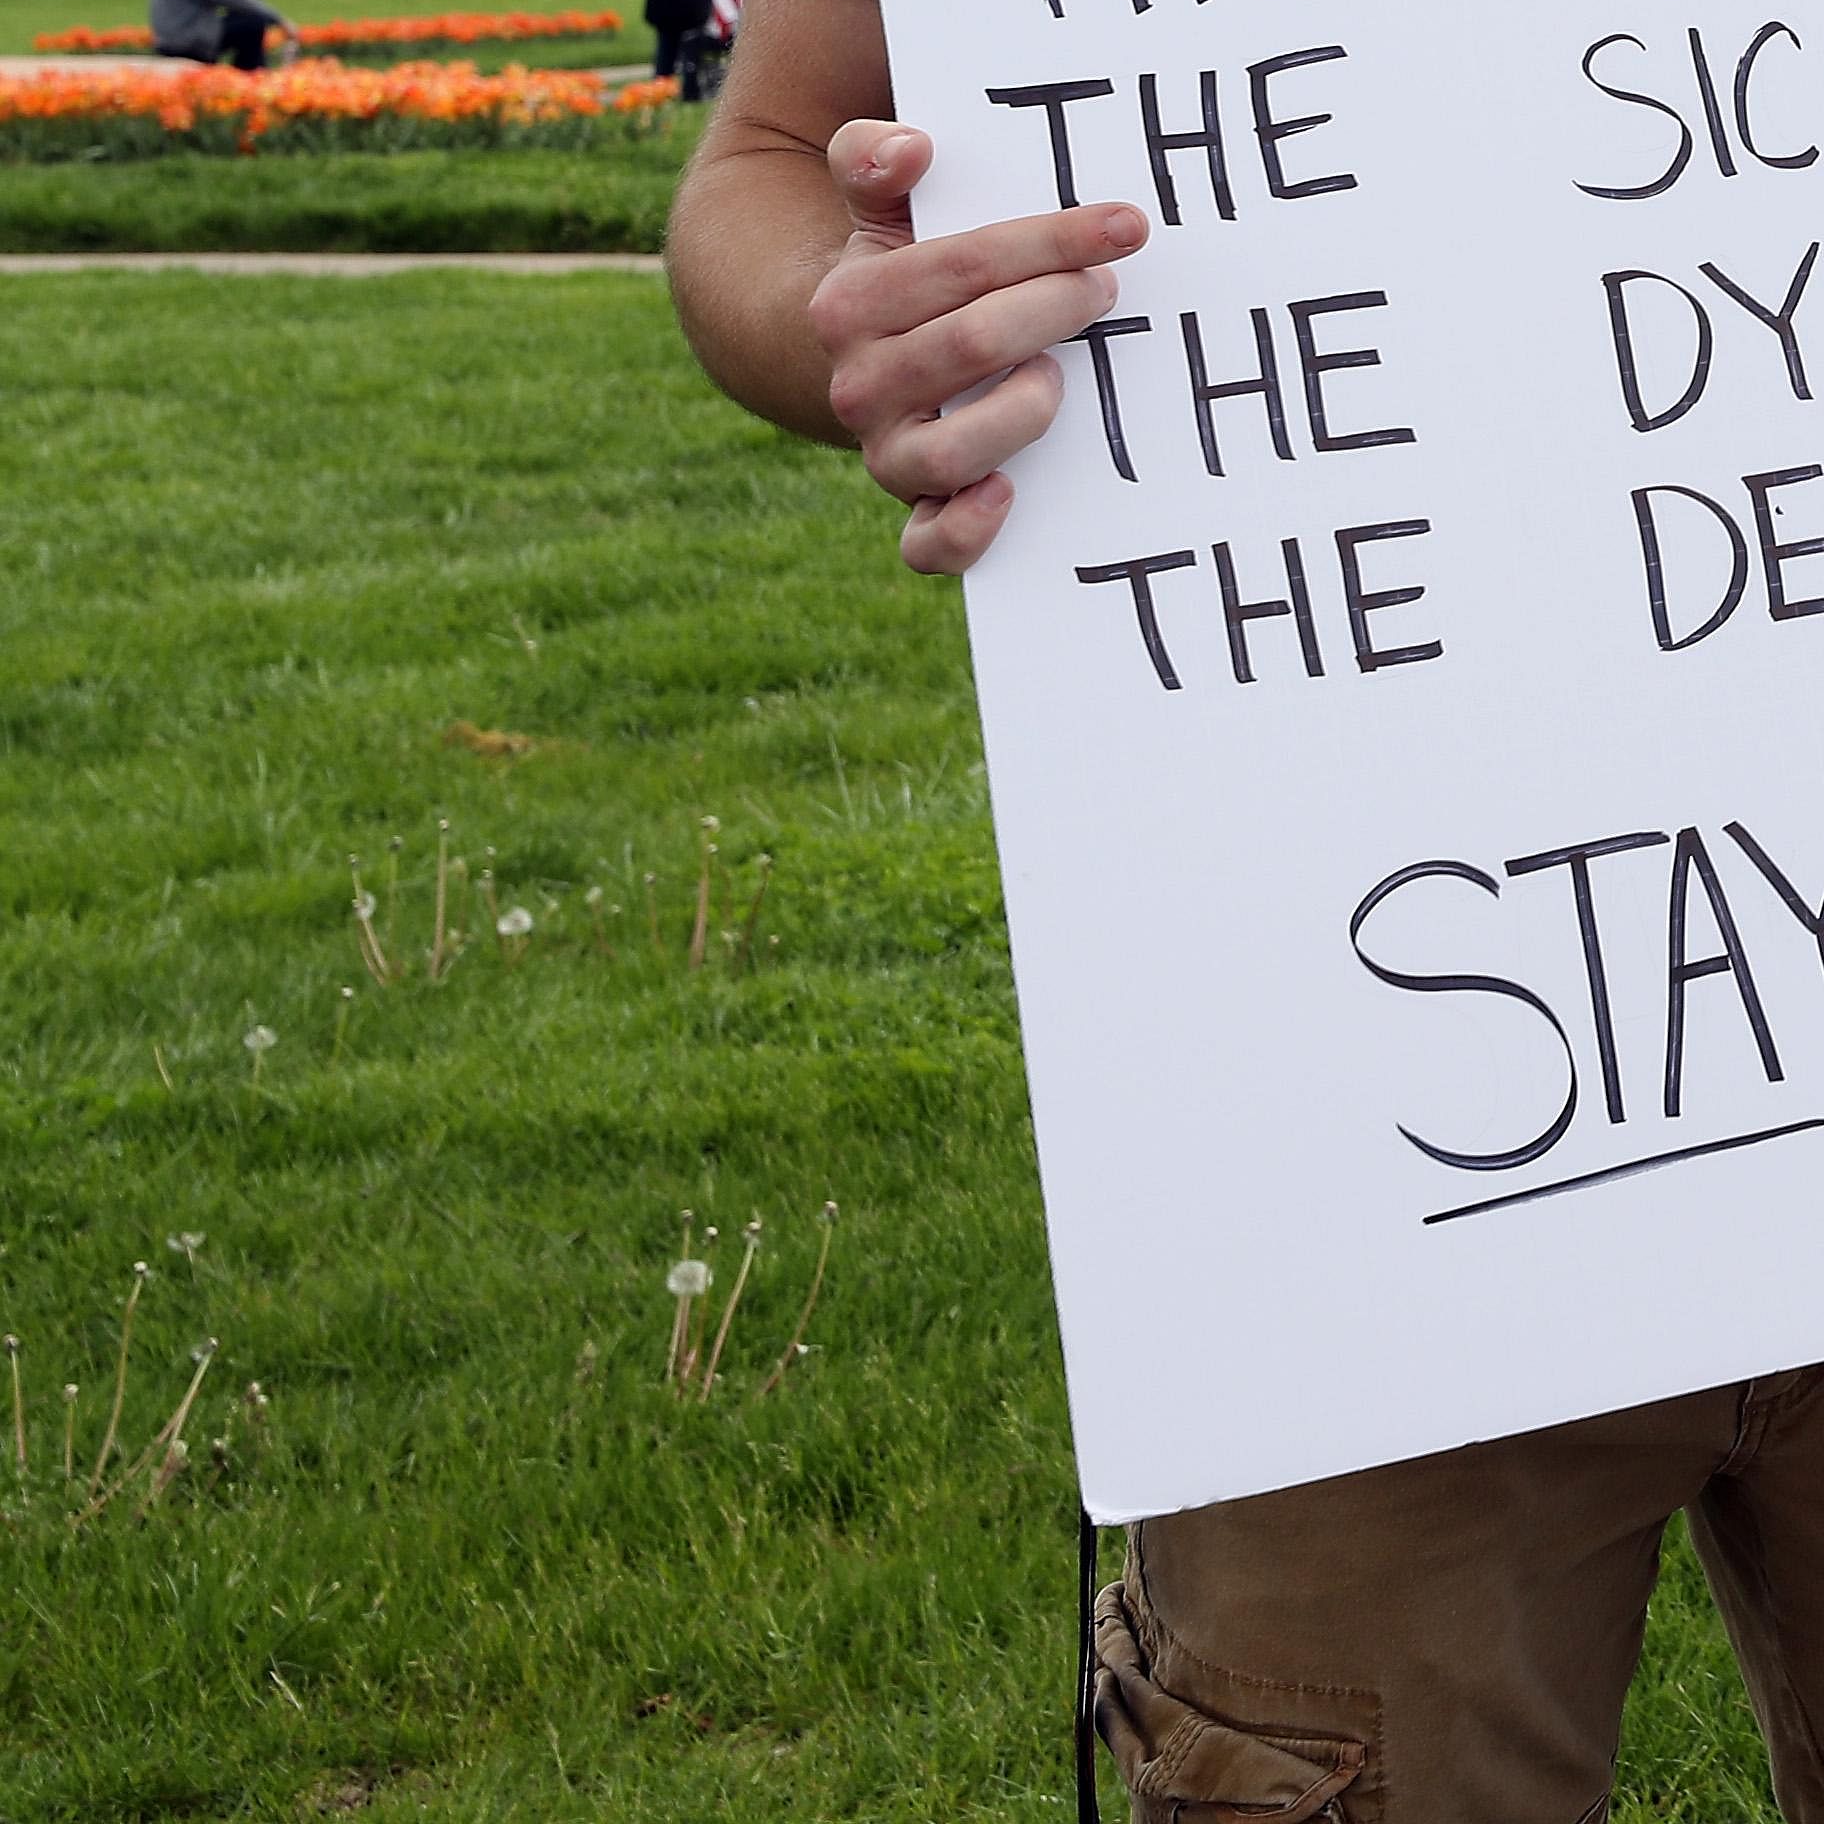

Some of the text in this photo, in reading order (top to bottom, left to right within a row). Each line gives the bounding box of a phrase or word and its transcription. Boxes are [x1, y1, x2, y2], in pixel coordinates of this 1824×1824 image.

[985, 46, 1358, 225] THE
[1060, 291, 1416, 482] THE
[1075, 519, 1443, 690] THE
